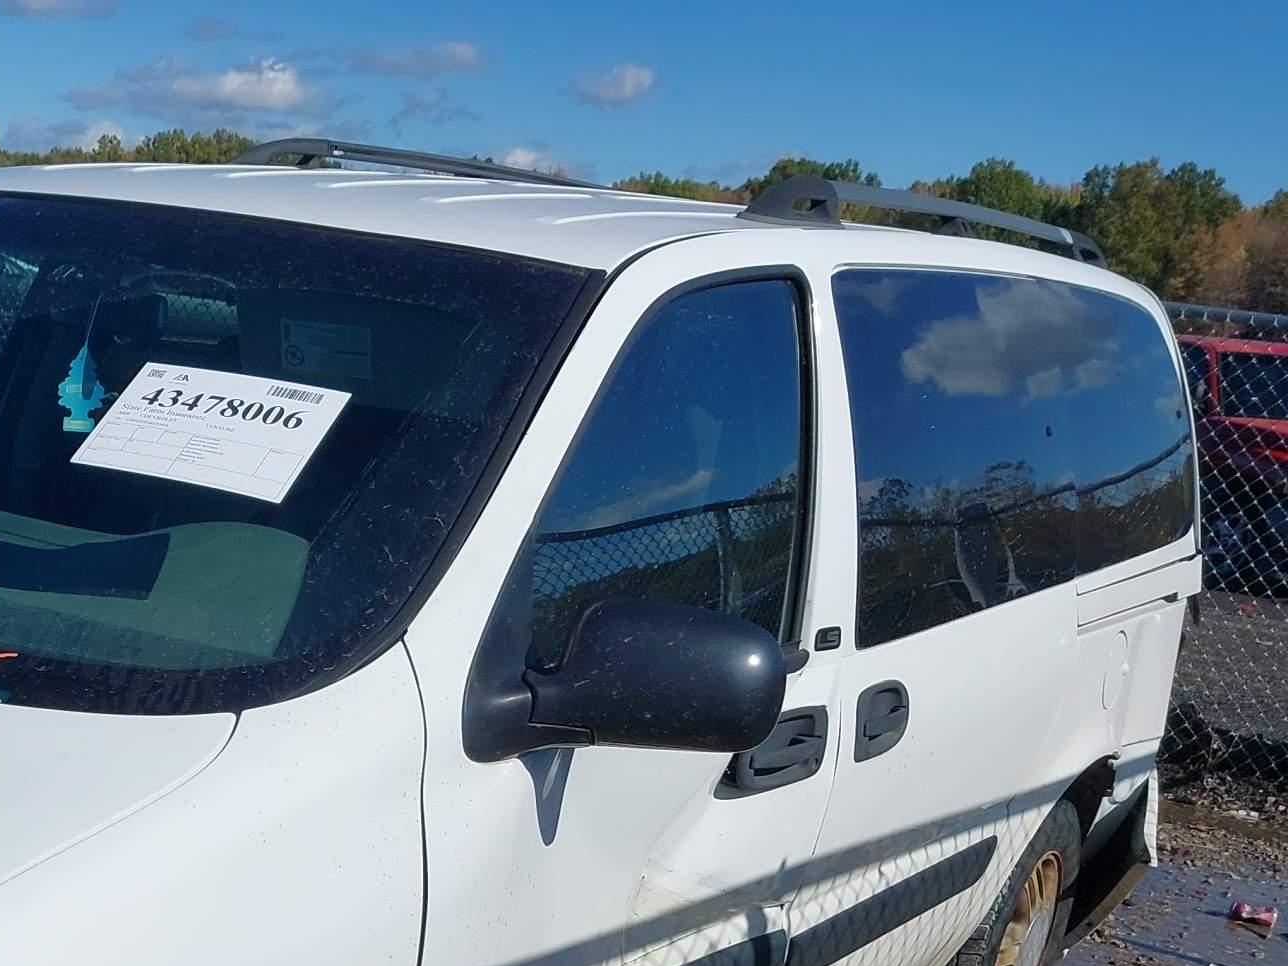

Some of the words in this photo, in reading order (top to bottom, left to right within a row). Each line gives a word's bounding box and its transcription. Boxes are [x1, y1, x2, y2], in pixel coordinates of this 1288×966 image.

[122, 402, 144, 412] State
[143, 405, 166, 416] Farm
[166, 409, 208, 422] Insurance
[140, 387, 311, 430] 43478006
